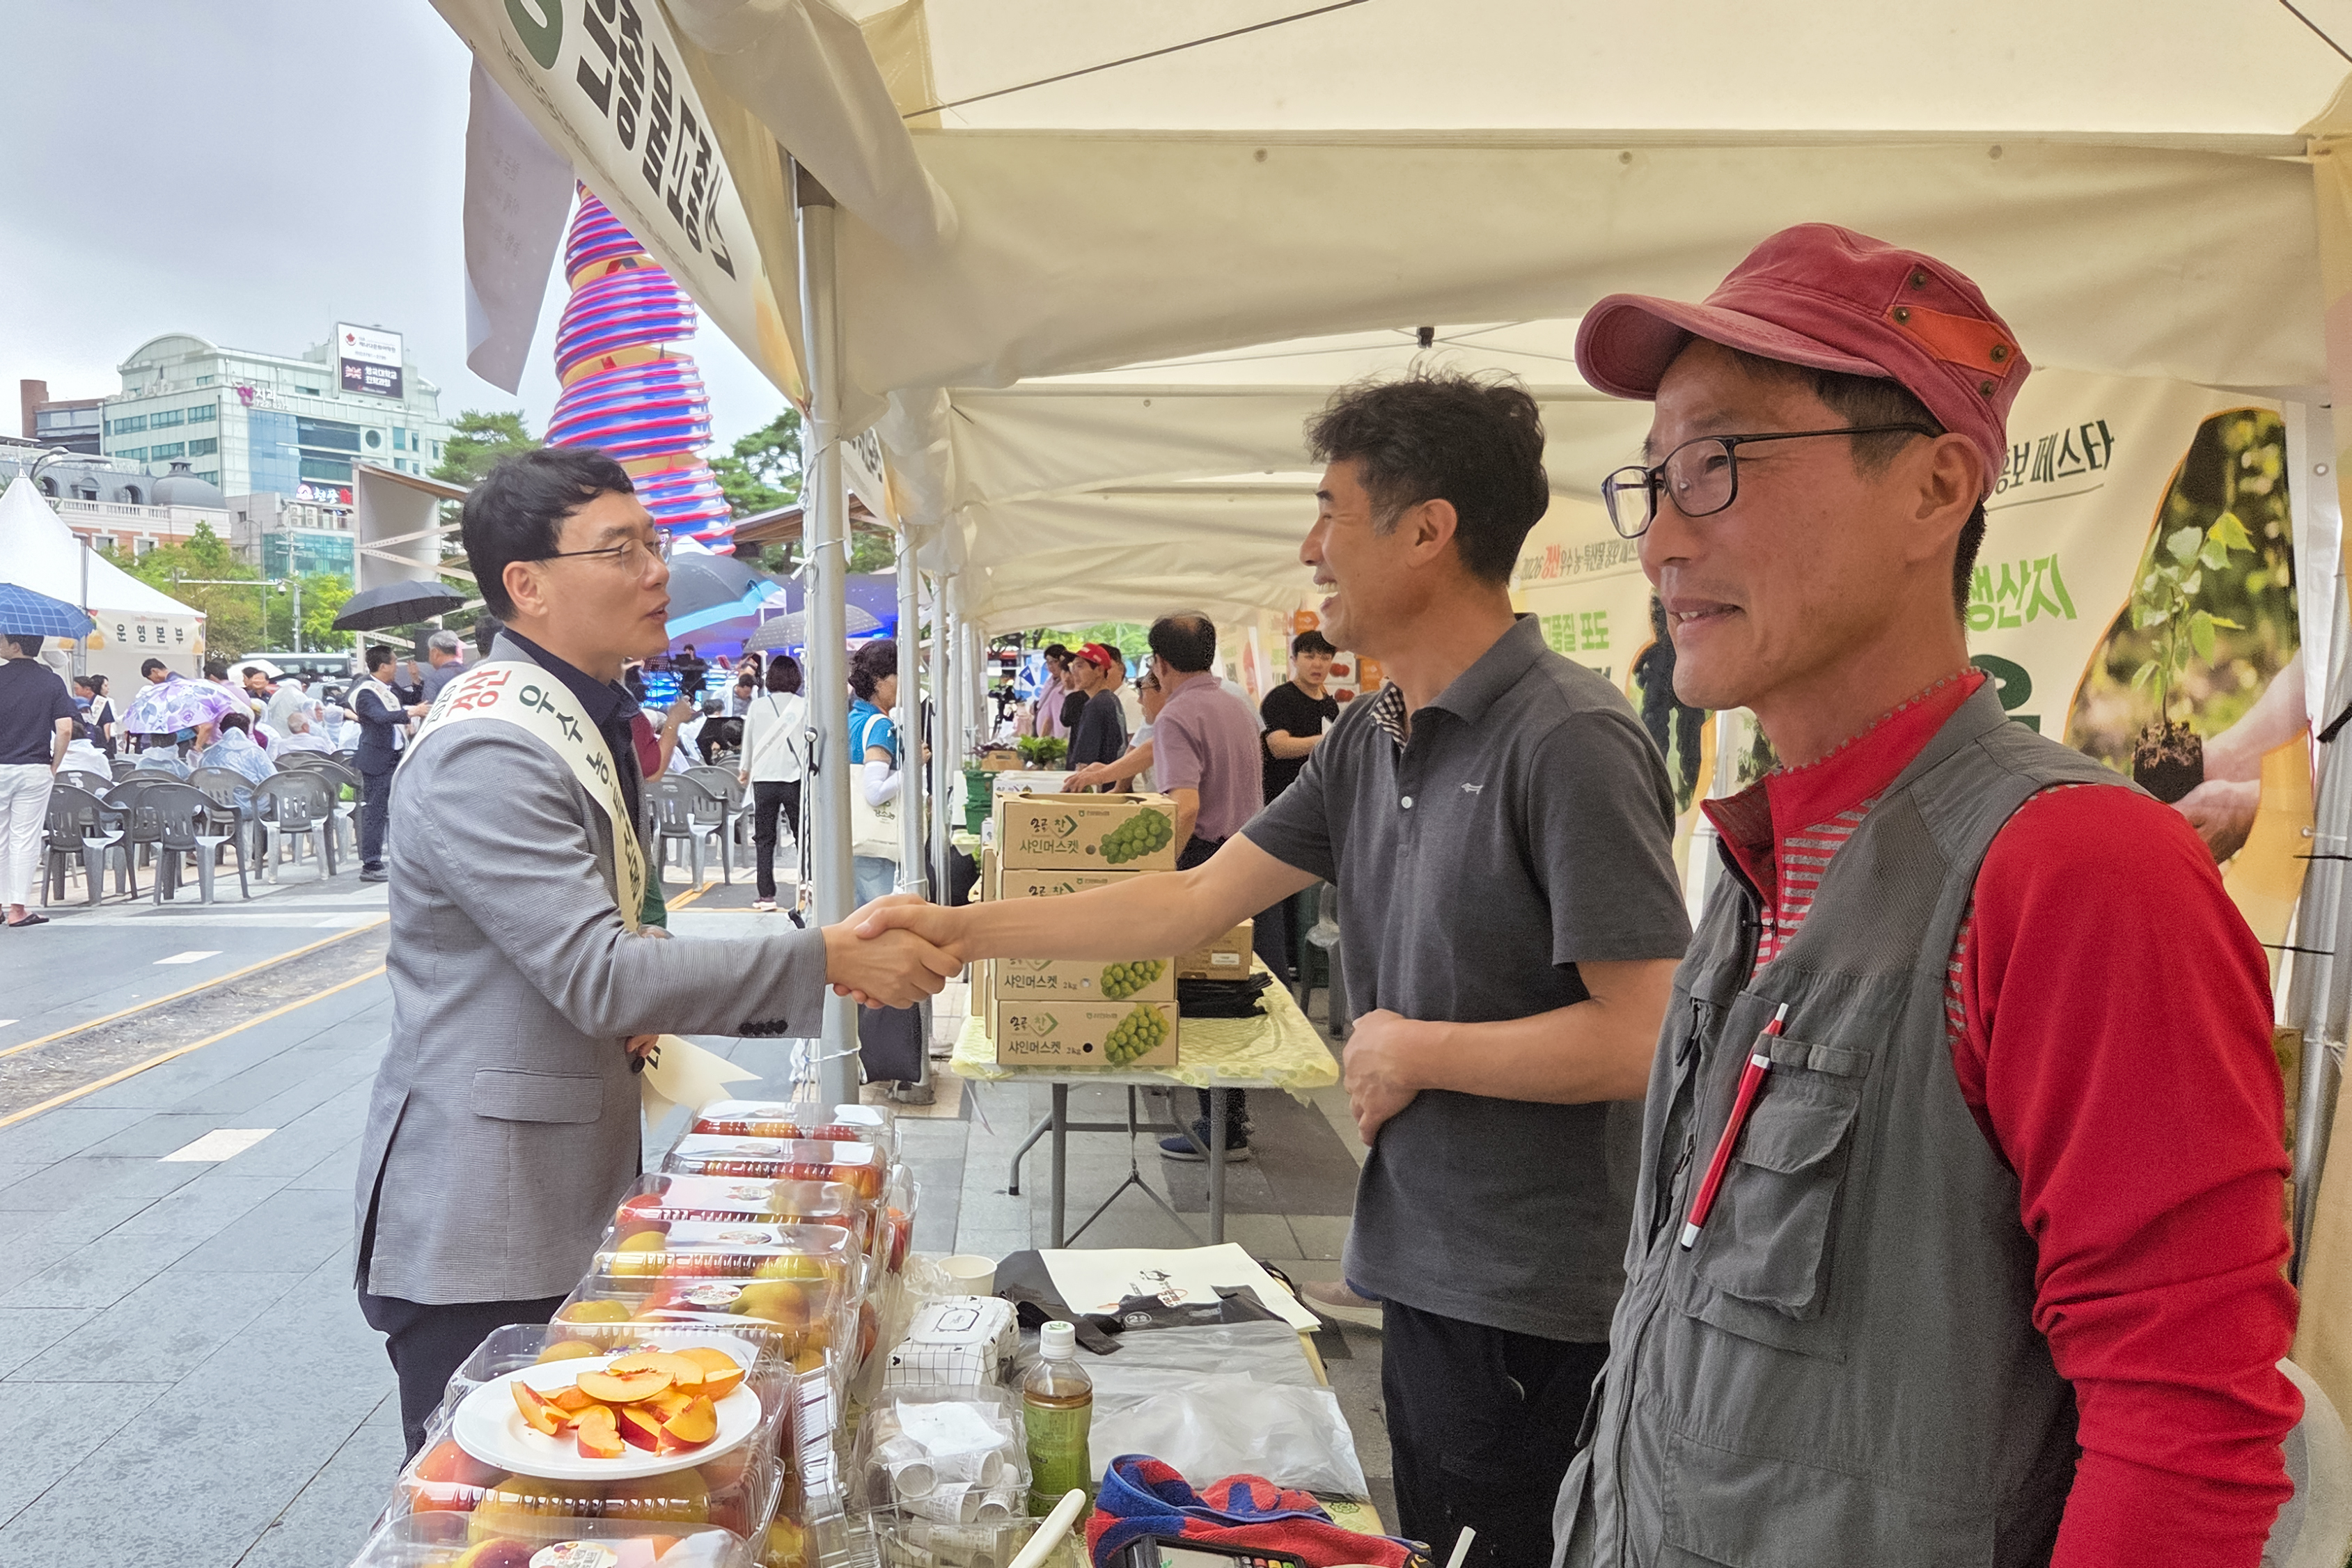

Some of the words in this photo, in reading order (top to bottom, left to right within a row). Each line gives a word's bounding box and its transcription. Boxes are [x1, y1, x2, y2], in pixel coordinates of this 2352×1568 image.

[2030, 420, 2115, 483] 페스타
[1579, 610, 1610, 650] 포도
[446, 670, 512, 718] 경산
[519, 684, 584, 744] 우수
[1019, 839, 1079, 854] 샤인머스켓
[1004, 974, 1058, 989] 샤인머스켓
[1008, 1041, 1061, 1055] 샤인머스켓
